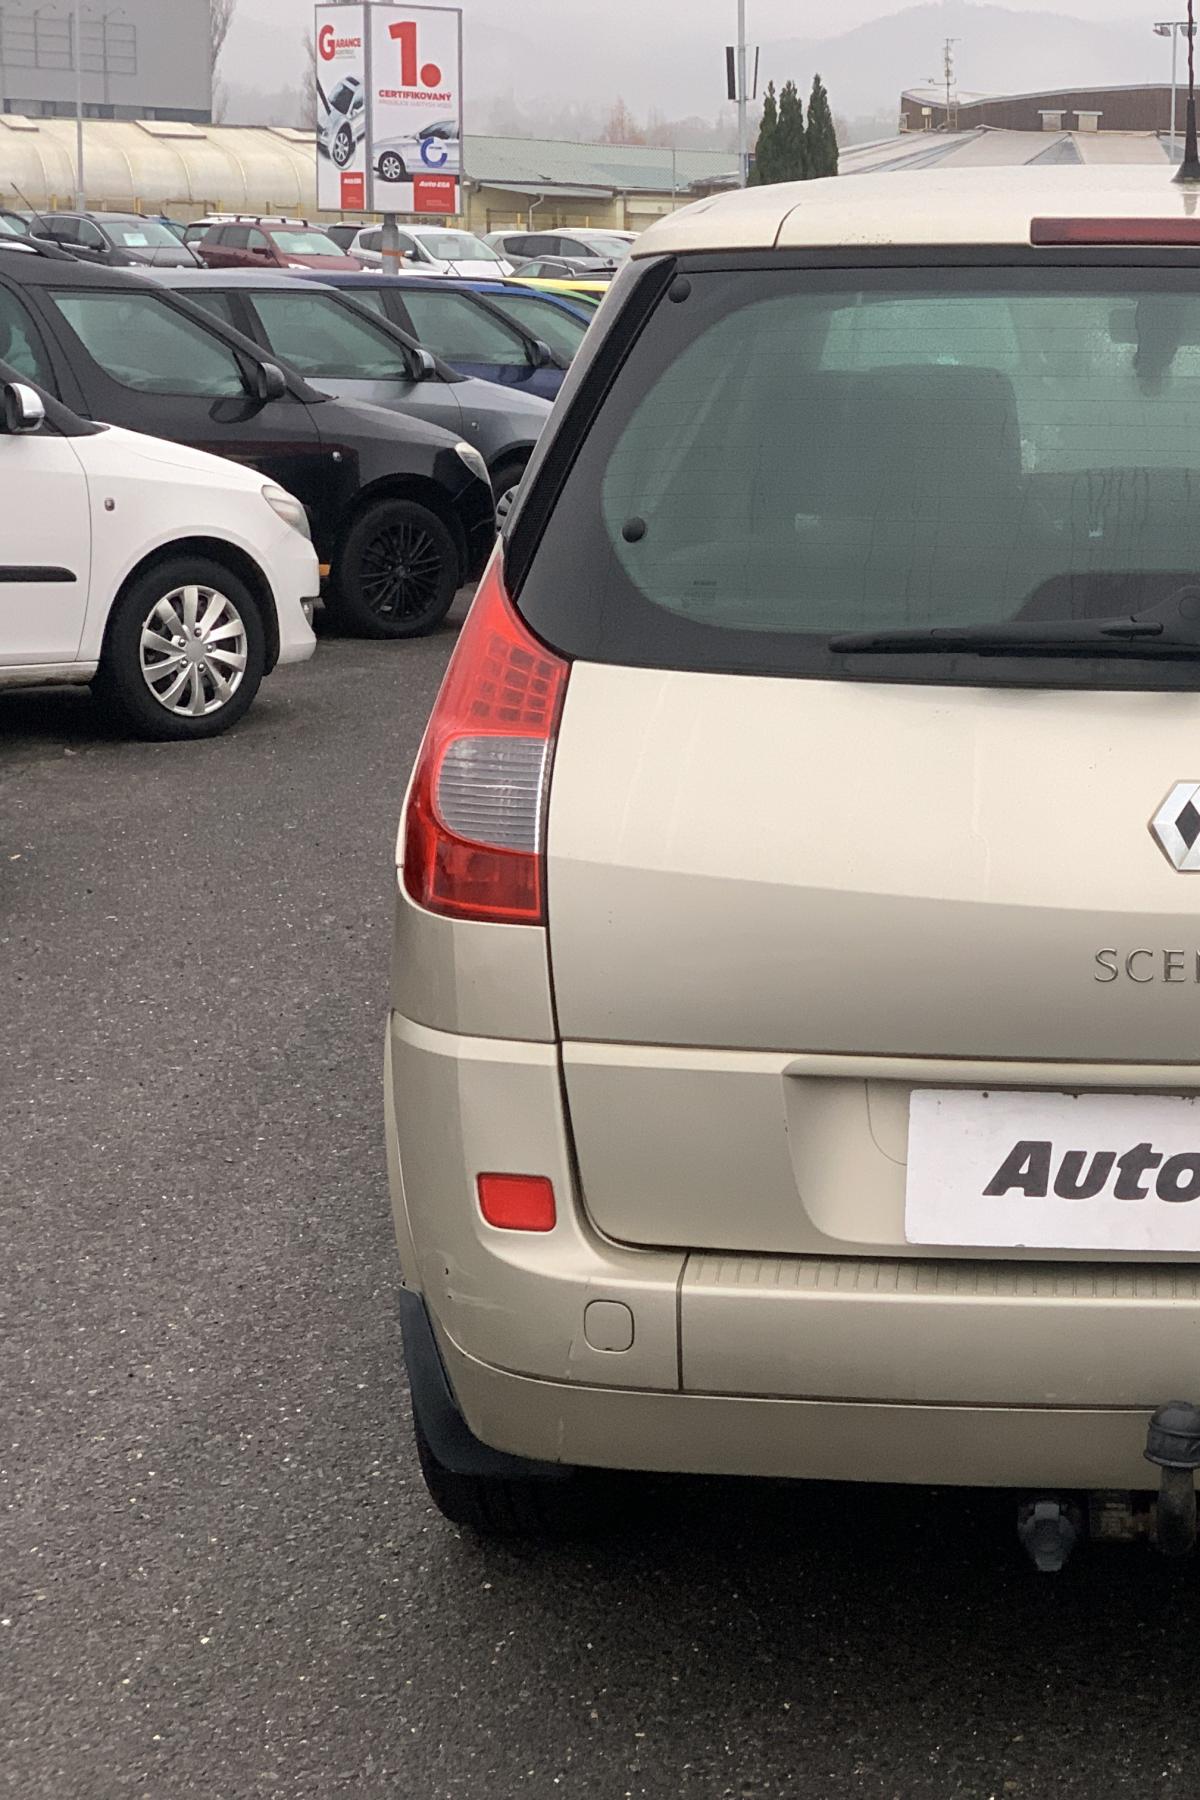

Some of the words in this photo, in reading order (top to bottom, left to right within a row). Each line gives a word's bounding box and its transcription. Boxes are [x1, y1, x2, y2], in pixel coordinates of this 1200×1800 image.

[319, 24, 361, 61] GARANCE
[389, 21, 442, 88] 1.
[378, 90, 452, 101] CERTIFIKOVANÝ
